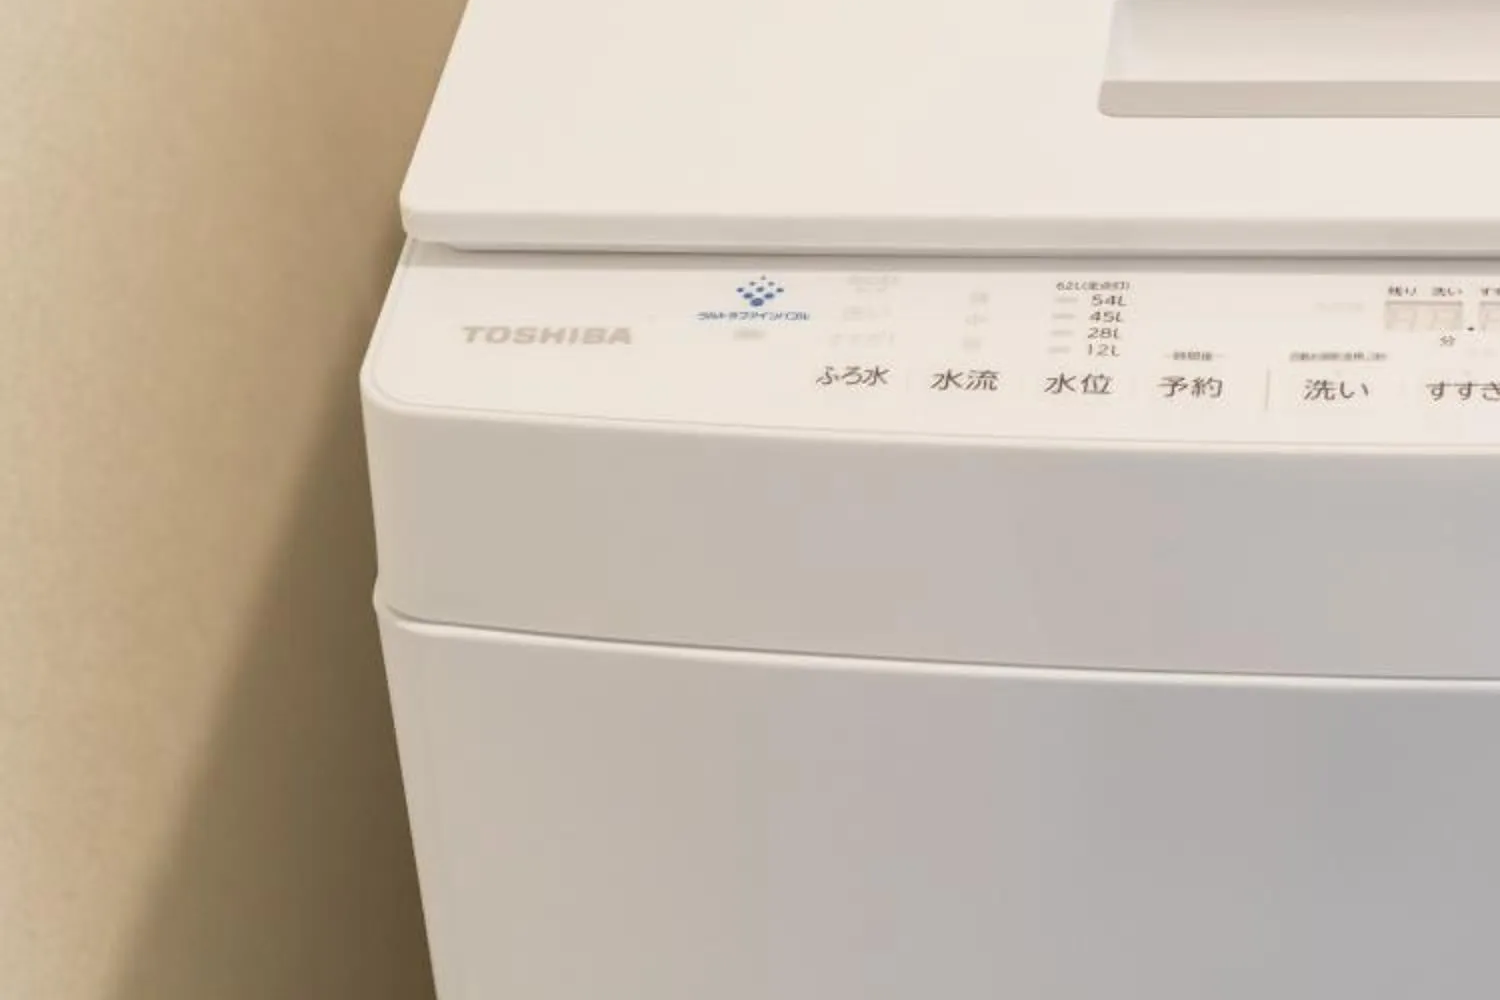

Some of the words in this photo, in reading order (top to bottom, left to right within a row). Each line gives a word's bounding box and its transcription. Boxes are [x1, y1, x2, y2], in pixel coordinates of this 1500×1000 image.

[1091, 294, 1128, 307] 54L
[1088, 311, 1124, 323] 45L
[462, 325, 633, 345] TOSHIBA
[1087, 327, 1122, 340] 28L
[816, 365, 890, 387] ふろ水
[930, 369, 999, 392] 水流
[1044, 373, 1114, 396] 水位
[1156, 376, 1224, 399] 予約
[1302, 379, 1371, 402] 洗い
